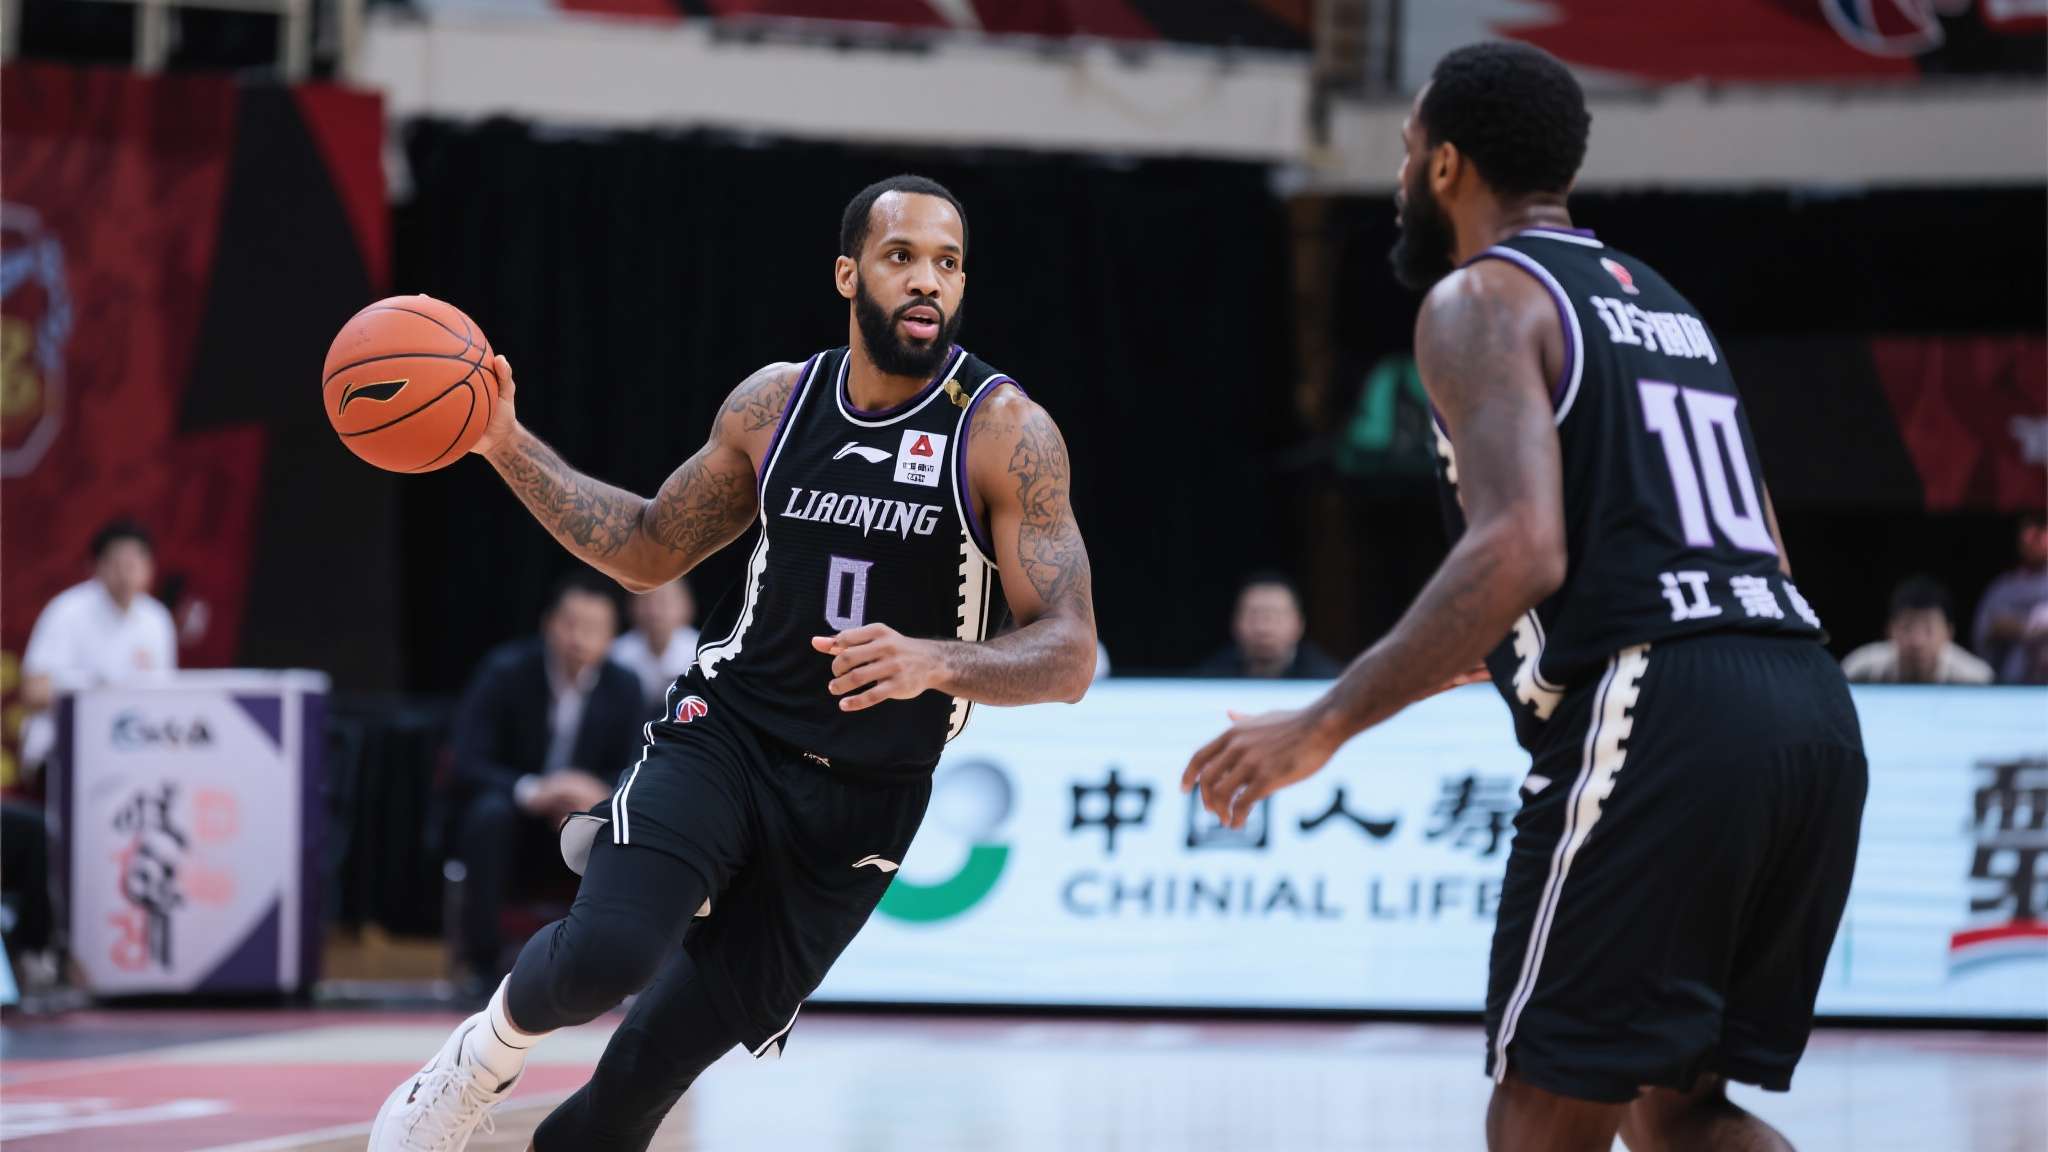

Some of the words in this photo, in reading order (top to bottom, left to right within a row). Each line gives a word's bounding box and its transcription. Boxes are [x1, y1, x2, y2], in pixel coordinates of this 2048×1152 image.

[1637, 379, 1778, 555] 10
[780, 487, 943, 541] LIAONING
[825, 554, 875, 632] 0
